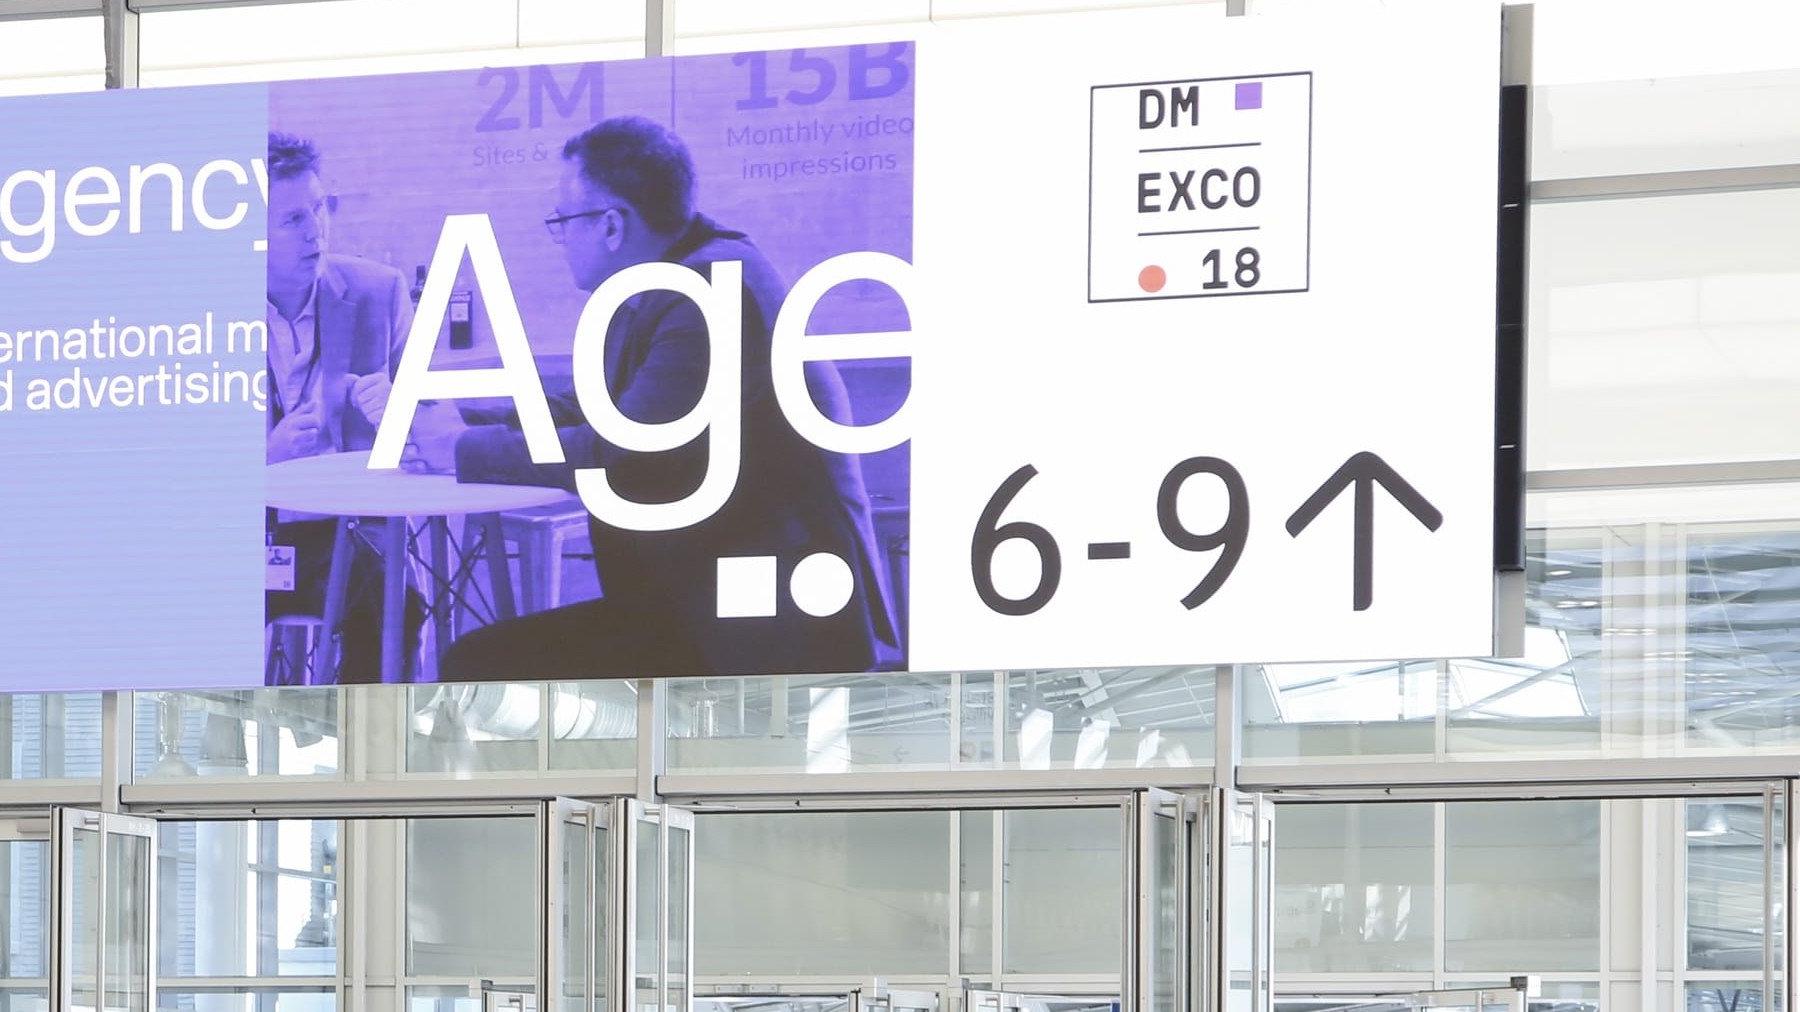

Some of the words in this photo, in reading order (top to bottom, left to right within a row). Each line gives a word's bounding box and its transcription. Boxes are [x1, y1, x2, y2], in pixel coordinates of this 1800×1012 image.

[475, 63, 604, 133] 2M
[731, 42, 910, 110] 15B
[1138, 85, 1199, 130] DM
[727, 118, 834, 147] Monthly
[841, 114, 913, 140] video
[473, 145, 526, 166] Sites
[532, 142, 547, 162] &
[743, 151, 897, 181] impressions
[1137, 166, 1261, 213] EXCO
[1202, 247, 1261, 290] 18
[227, 320, 267, 353] m
[366, 213, 911, 531] Age
[970, 456, 1250, 616] 6-9
